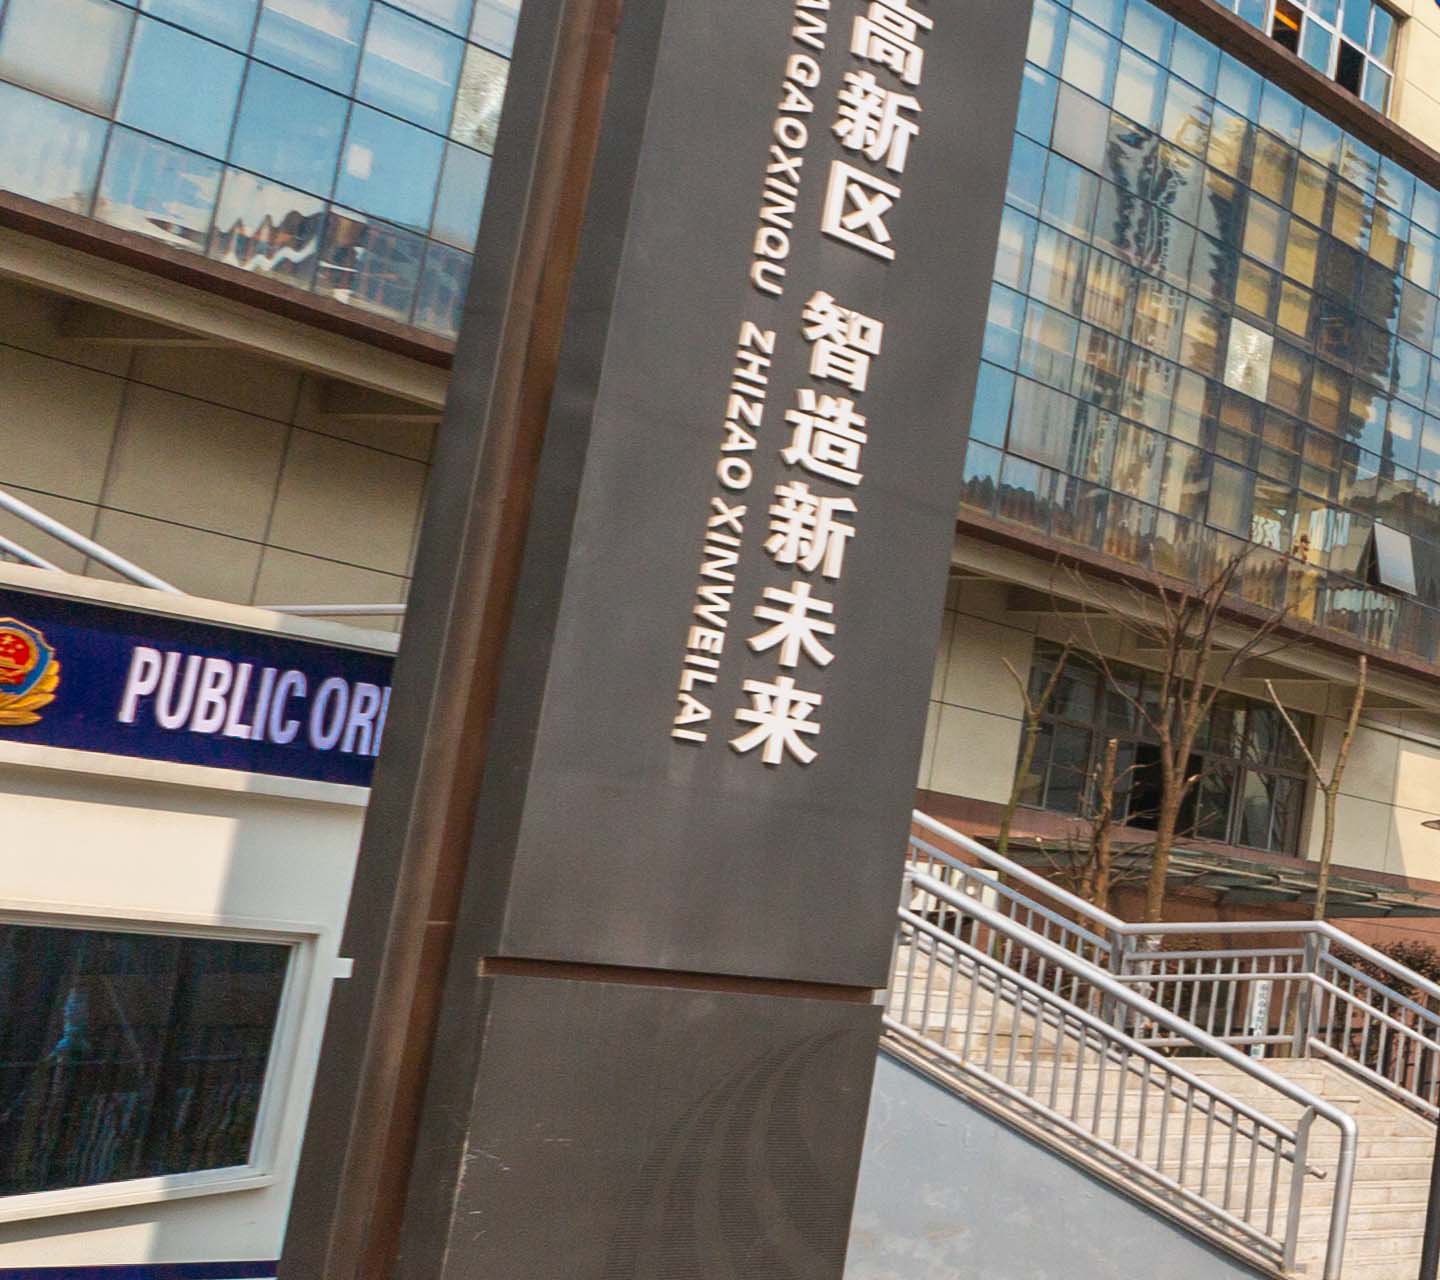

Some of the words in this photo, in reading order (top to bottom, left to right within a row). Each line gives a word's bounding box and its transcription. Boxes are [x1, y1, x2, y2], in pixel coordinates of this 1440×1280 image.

[750, 53, 823, 296] GAOXINQU
[716, 320, 777, 490] ZHIZAO
[671, 497, 747, 742] XINWEILAI
[728, 290, 884, 765] 智造新未来
[118, 645, 307, 745] PUBLIC
